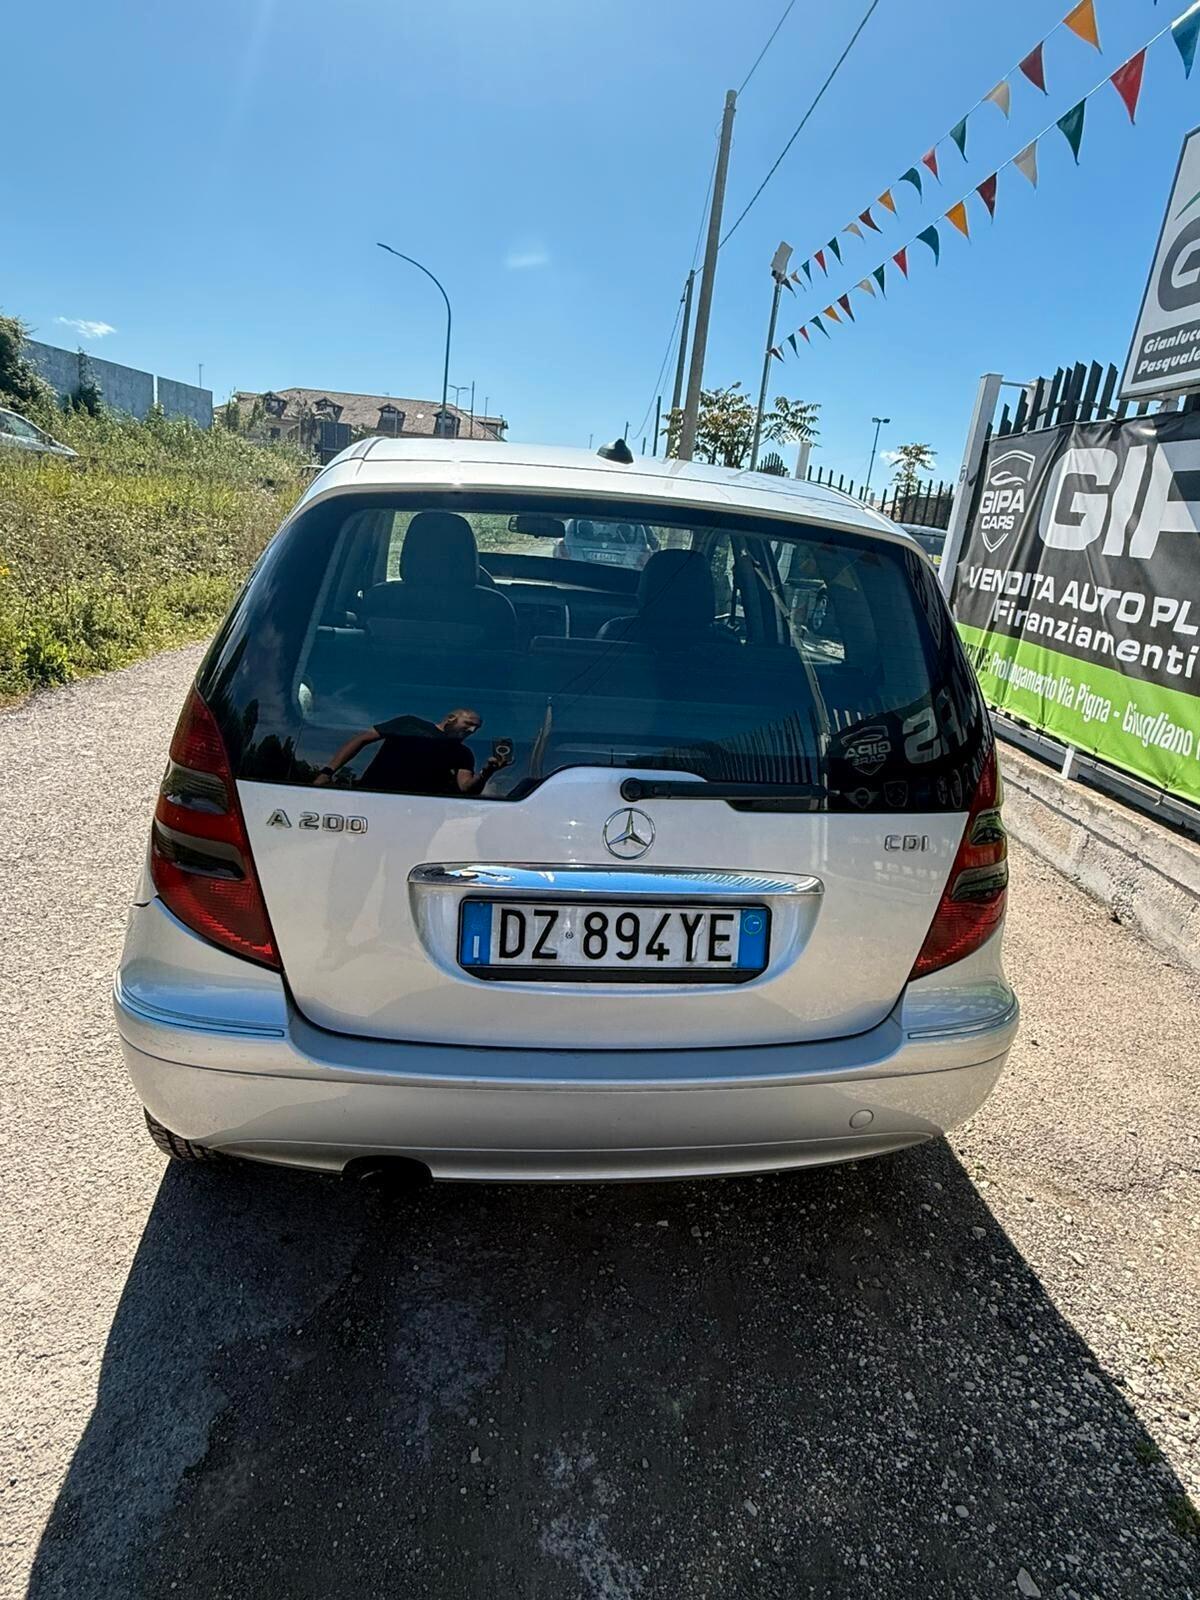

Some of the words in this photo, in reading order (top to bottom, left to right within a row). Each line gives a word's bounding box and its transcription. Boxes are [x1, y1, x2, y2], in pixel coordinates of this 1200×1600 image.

[979, 488, 1025, 514] GIPA
[981, 515, 1015, 530] CARS
[969, 566, 1055, 604] VENDITA
[1058, 580, 1146, 624] AUTO
[993, 600, 1200, 678] Finanziamenti
[1057, 675, 1076, 708] Via
[1075, 682, 1112, 723] Pigna
[1122, 701, 1194, 756] Giugliano
[266, 808, 292, 829] A
[299, 811, 368, 834] 200
[884, 834, 928, 852] CDI
[499, 908, 560, 960] DZ
[582, 911, 735, 963] 894YE
